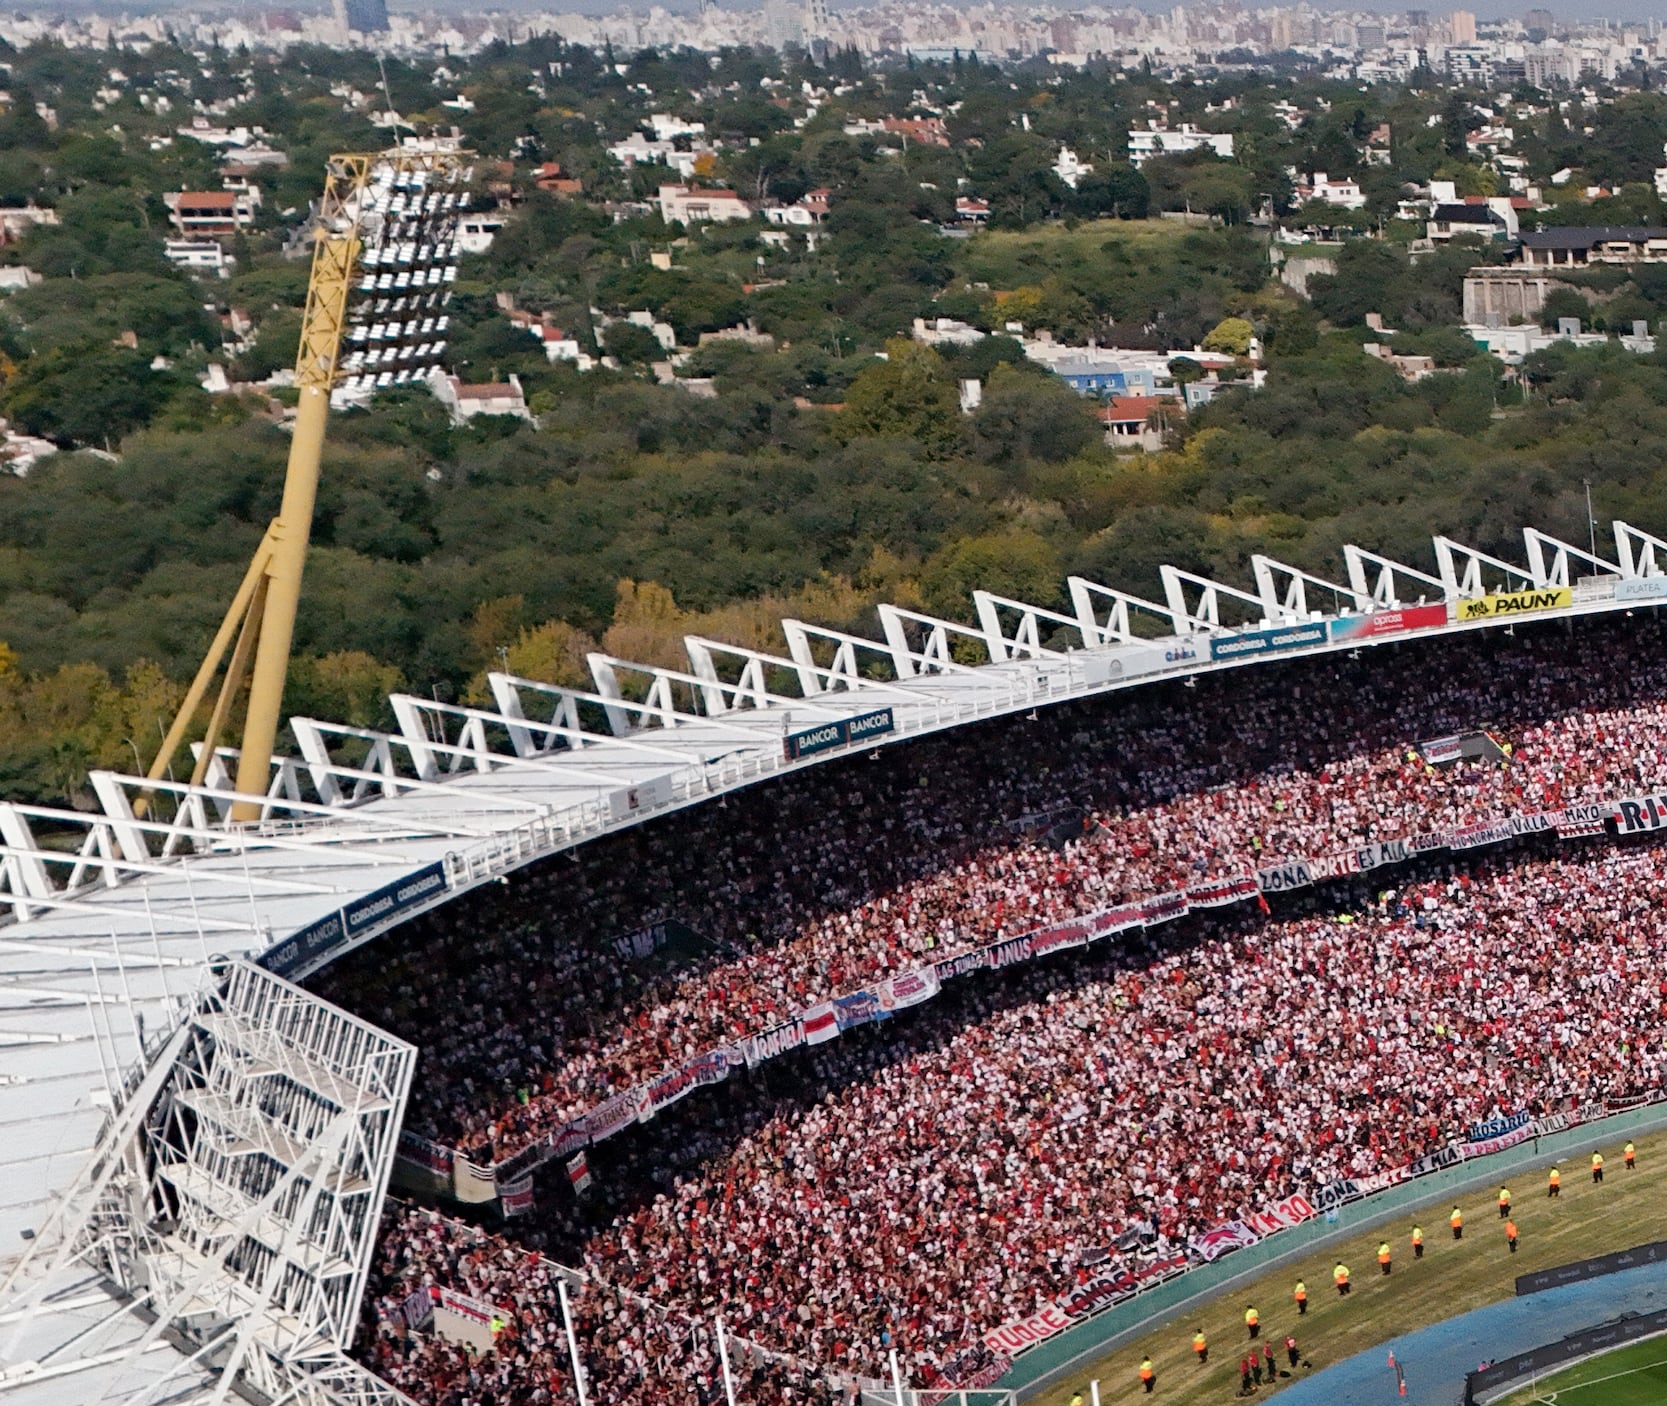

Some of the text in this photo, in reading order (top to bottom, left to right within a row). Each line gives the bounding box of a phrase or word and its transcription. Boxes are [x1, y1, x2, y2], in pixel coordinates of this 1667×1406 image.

[1496, 592, 1562, 612] PAUNY
[1626, 583, 1660, 594] PLATEA
[1217, 630, 1322, 654] CORDOBESA CORDOBESA
[799, 713, 888, 748] BANCOR BANCOR
[1512, 805, 1600, 831] VILLA DE MAYO
[1260, 841, 1408, 890] ZONA NORTE ES MIA
[350, 874, 441, 925] CORDOBESA CORDOBESA
[267, 919, 338, 970] BANCOR BANCOR
[988, 937, 1032, 969] LANUS
[1470, 1112, 1530, 1139] ROSARIO
[1543, 1117, 1569, 1132] VILLA
[1475, 1127, 1532, 1154] PEREYRA
[1316, 1180, 1358, 1208] ZONA
[1410, 1159, 1424, 1174] ES
[1431, 1147, 1458, 1169] MIA
[1279, 1196, 1312, 1223] 30
